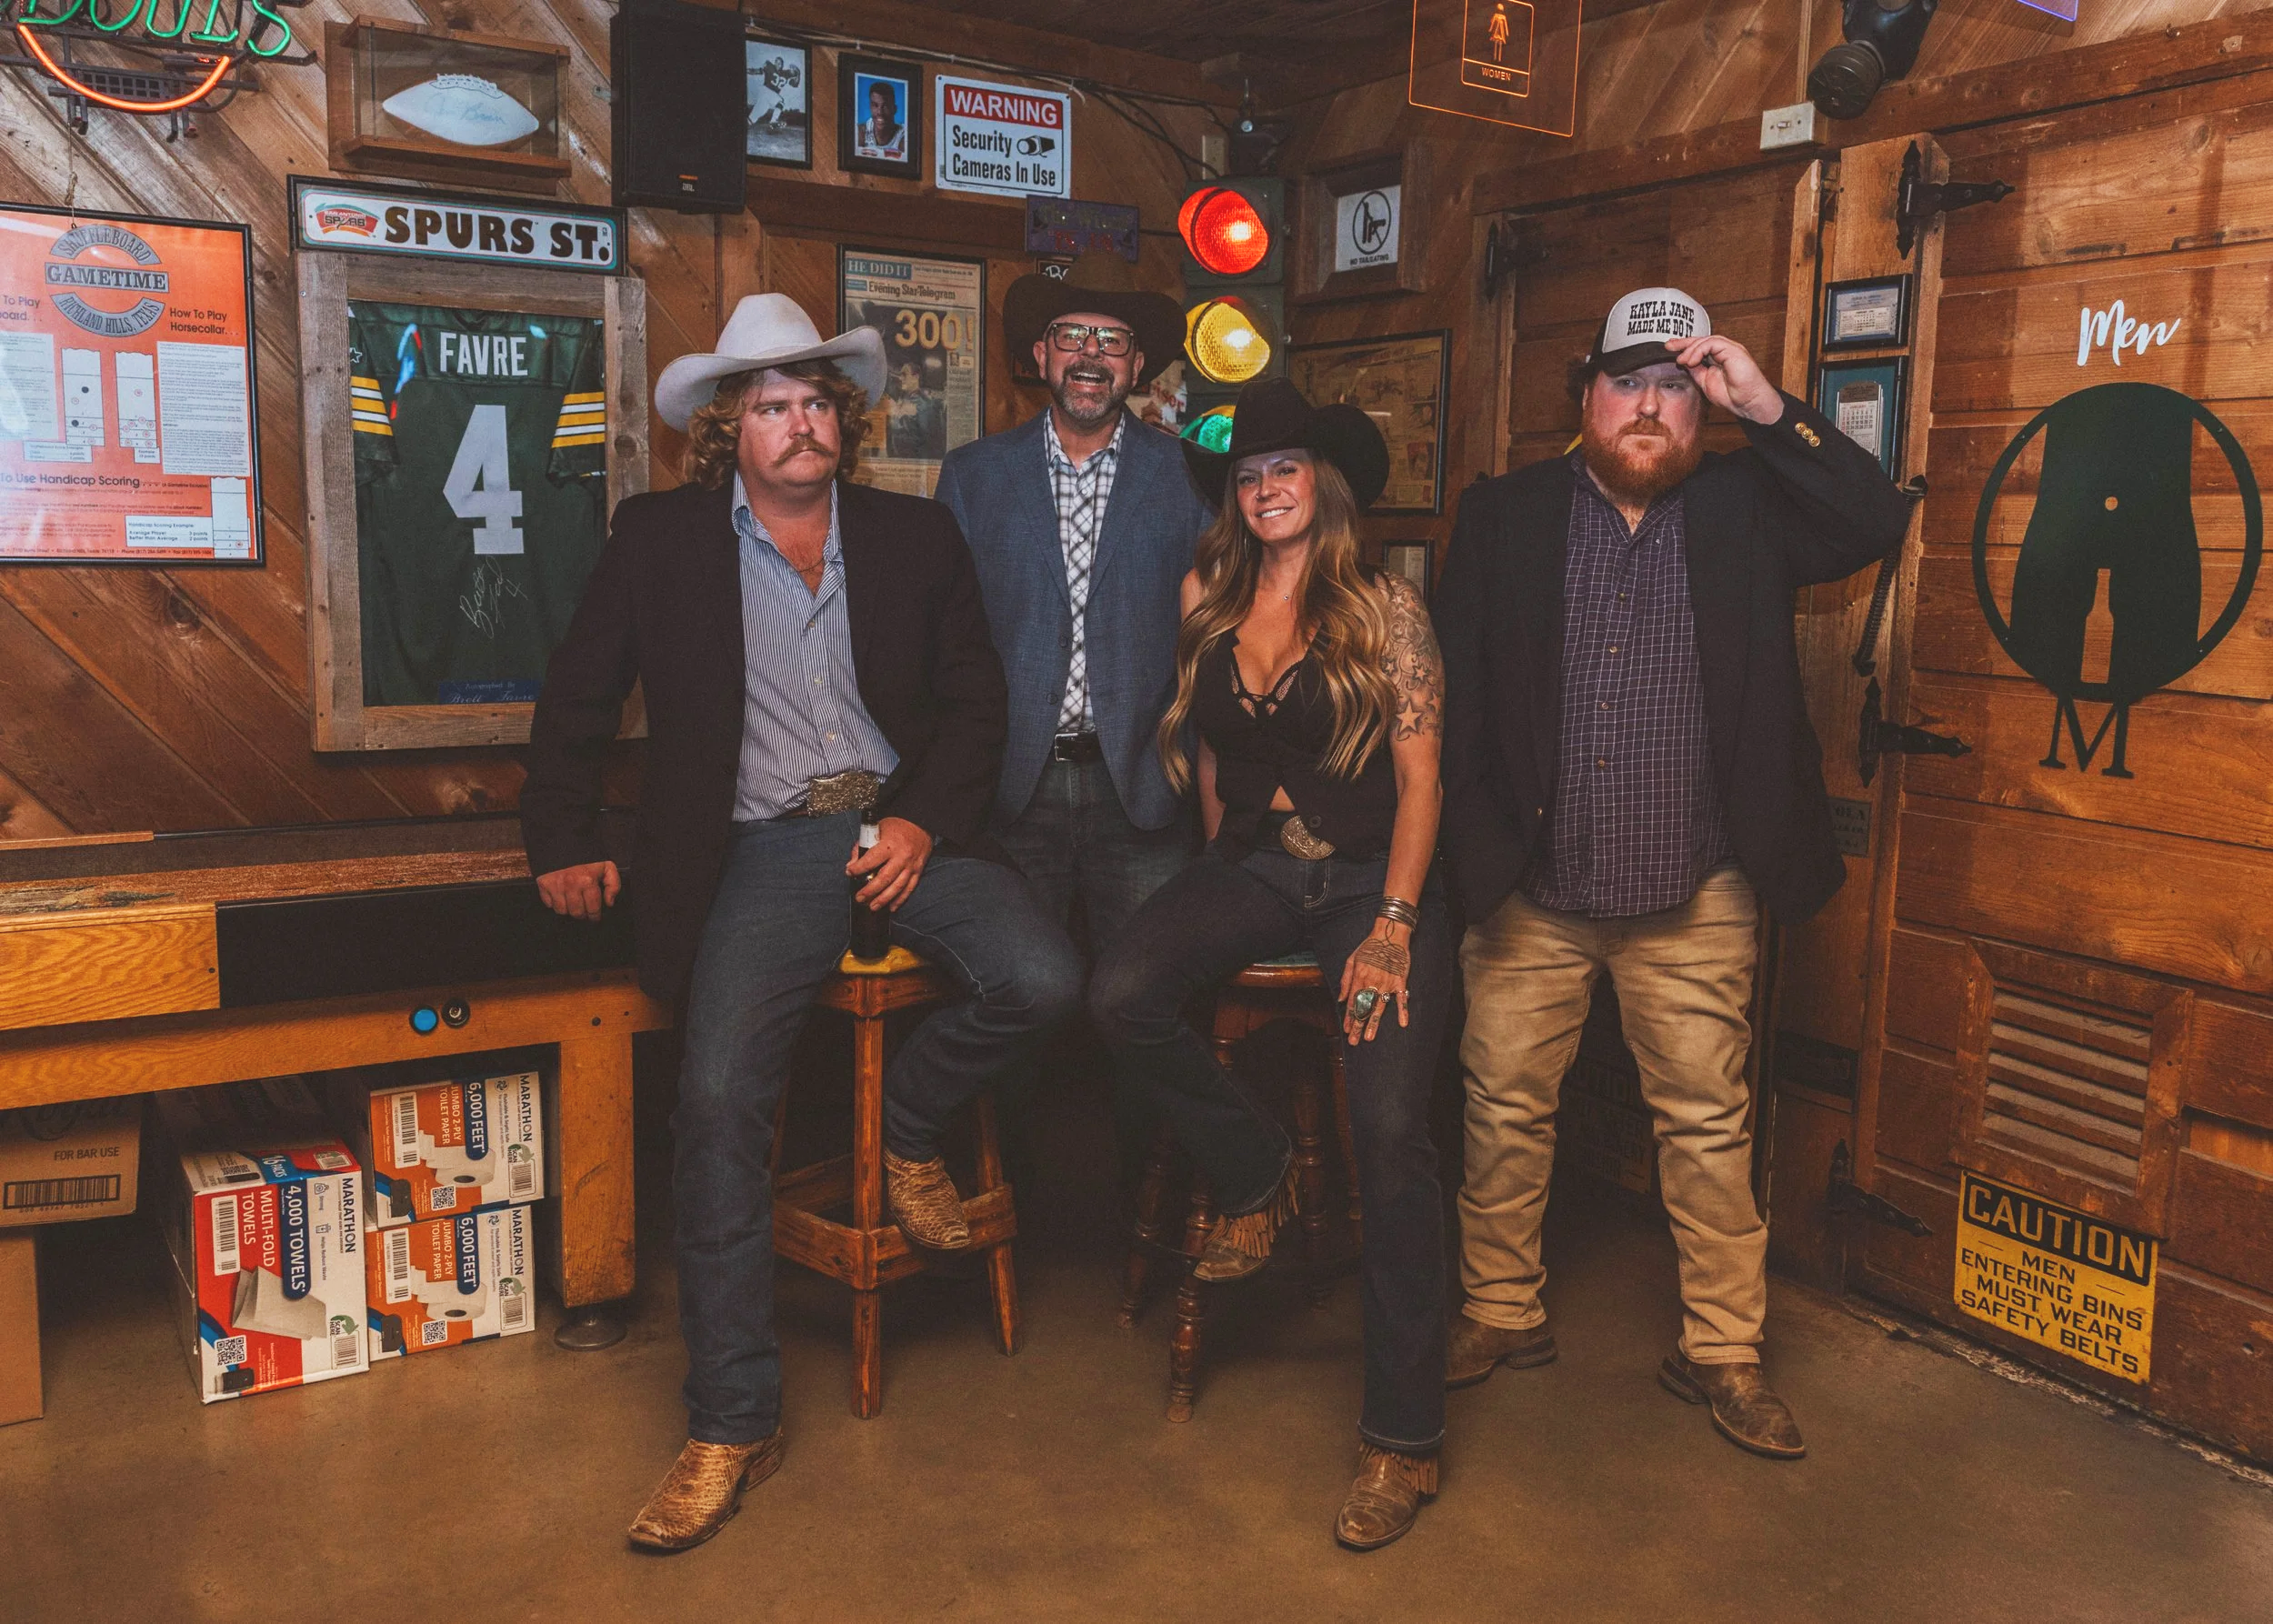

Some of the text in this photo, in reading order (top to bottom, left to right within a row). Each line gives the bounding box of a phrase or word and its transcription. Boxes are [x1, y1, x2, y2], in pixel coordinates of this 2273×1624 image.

[1481, 65, 1511, 82] WOMEN
[950, 89, 1057, 125] WARNING
[953, 125, 1012, 158] Security
[953, 154, 1056, 186] Cameras In Use
[58, 226, 151, 261] SHUFFLEBOARD
[384, 206, 610, 262] SPURS ST.
[47, 265, 166, 290] GAMETIME
[848, 260, 867, 272] HE
[870, 263, 893, 275] DID
[896, 265, 908, 277] IT
[869, 281, 900, 297] Evening
[4, 295, 40, 309] To Play
[59, 296, 103, 330] RICHLAND
[135, 302, 160, 329] TEXAS
[170, 307, 227, 322] How To Play
[1629, 301, 1694, 324] KAYLA JANE
[895, 309, 975, 352] 300!
[1627, 318, 1694, 338] MADE ME DO IT
[2078, 299, 2181, 366] Men
[439, 331, 528, 376] FAVRE
[15, 474, 36, 484] Use
[39, 475, 95, 487] Handicap
[98, 476, 140, 488] Scoring
[443, 405, 525, 555] 4
[2038, 691, 2135, 779] M
[439, 1088, 451, 1145] TOILET PAPER
[451, 1086, 462, 1141] JUMBO 2-PLY
[469, 1082, 483, 1118] 6,000
[520, 1075, 533, 1142] MARATHON
[54, 1147, 120, 1161] FOR BAR USE
[242, 1192, 256, 1245] TOWELS
[285, 1185, 302, 1226] 4,000
[342, 1178, 355, 1253] MARATHON
[260, 1190, 275, 1267] MULTI-FOLD
[443, 1221, 454, 1276] JUMBO 2-PLY
[461, 1217, 475, 1253] 6,000
[512, 1208, 524, 1276] MARATHON
[1968, 1184, 2145, 1278] CAUTION
[431, 1222, 442, 1279] TOILET PAPER
[2022, 1250, 2075, 1284] MEN
[1961, 1248, 2142, 1331] ENTERING BINS
[1977, 1275, 2122, 1346] MUST WEAR
[1961, 1288, 2138, 1374] SAFETY BELTS
